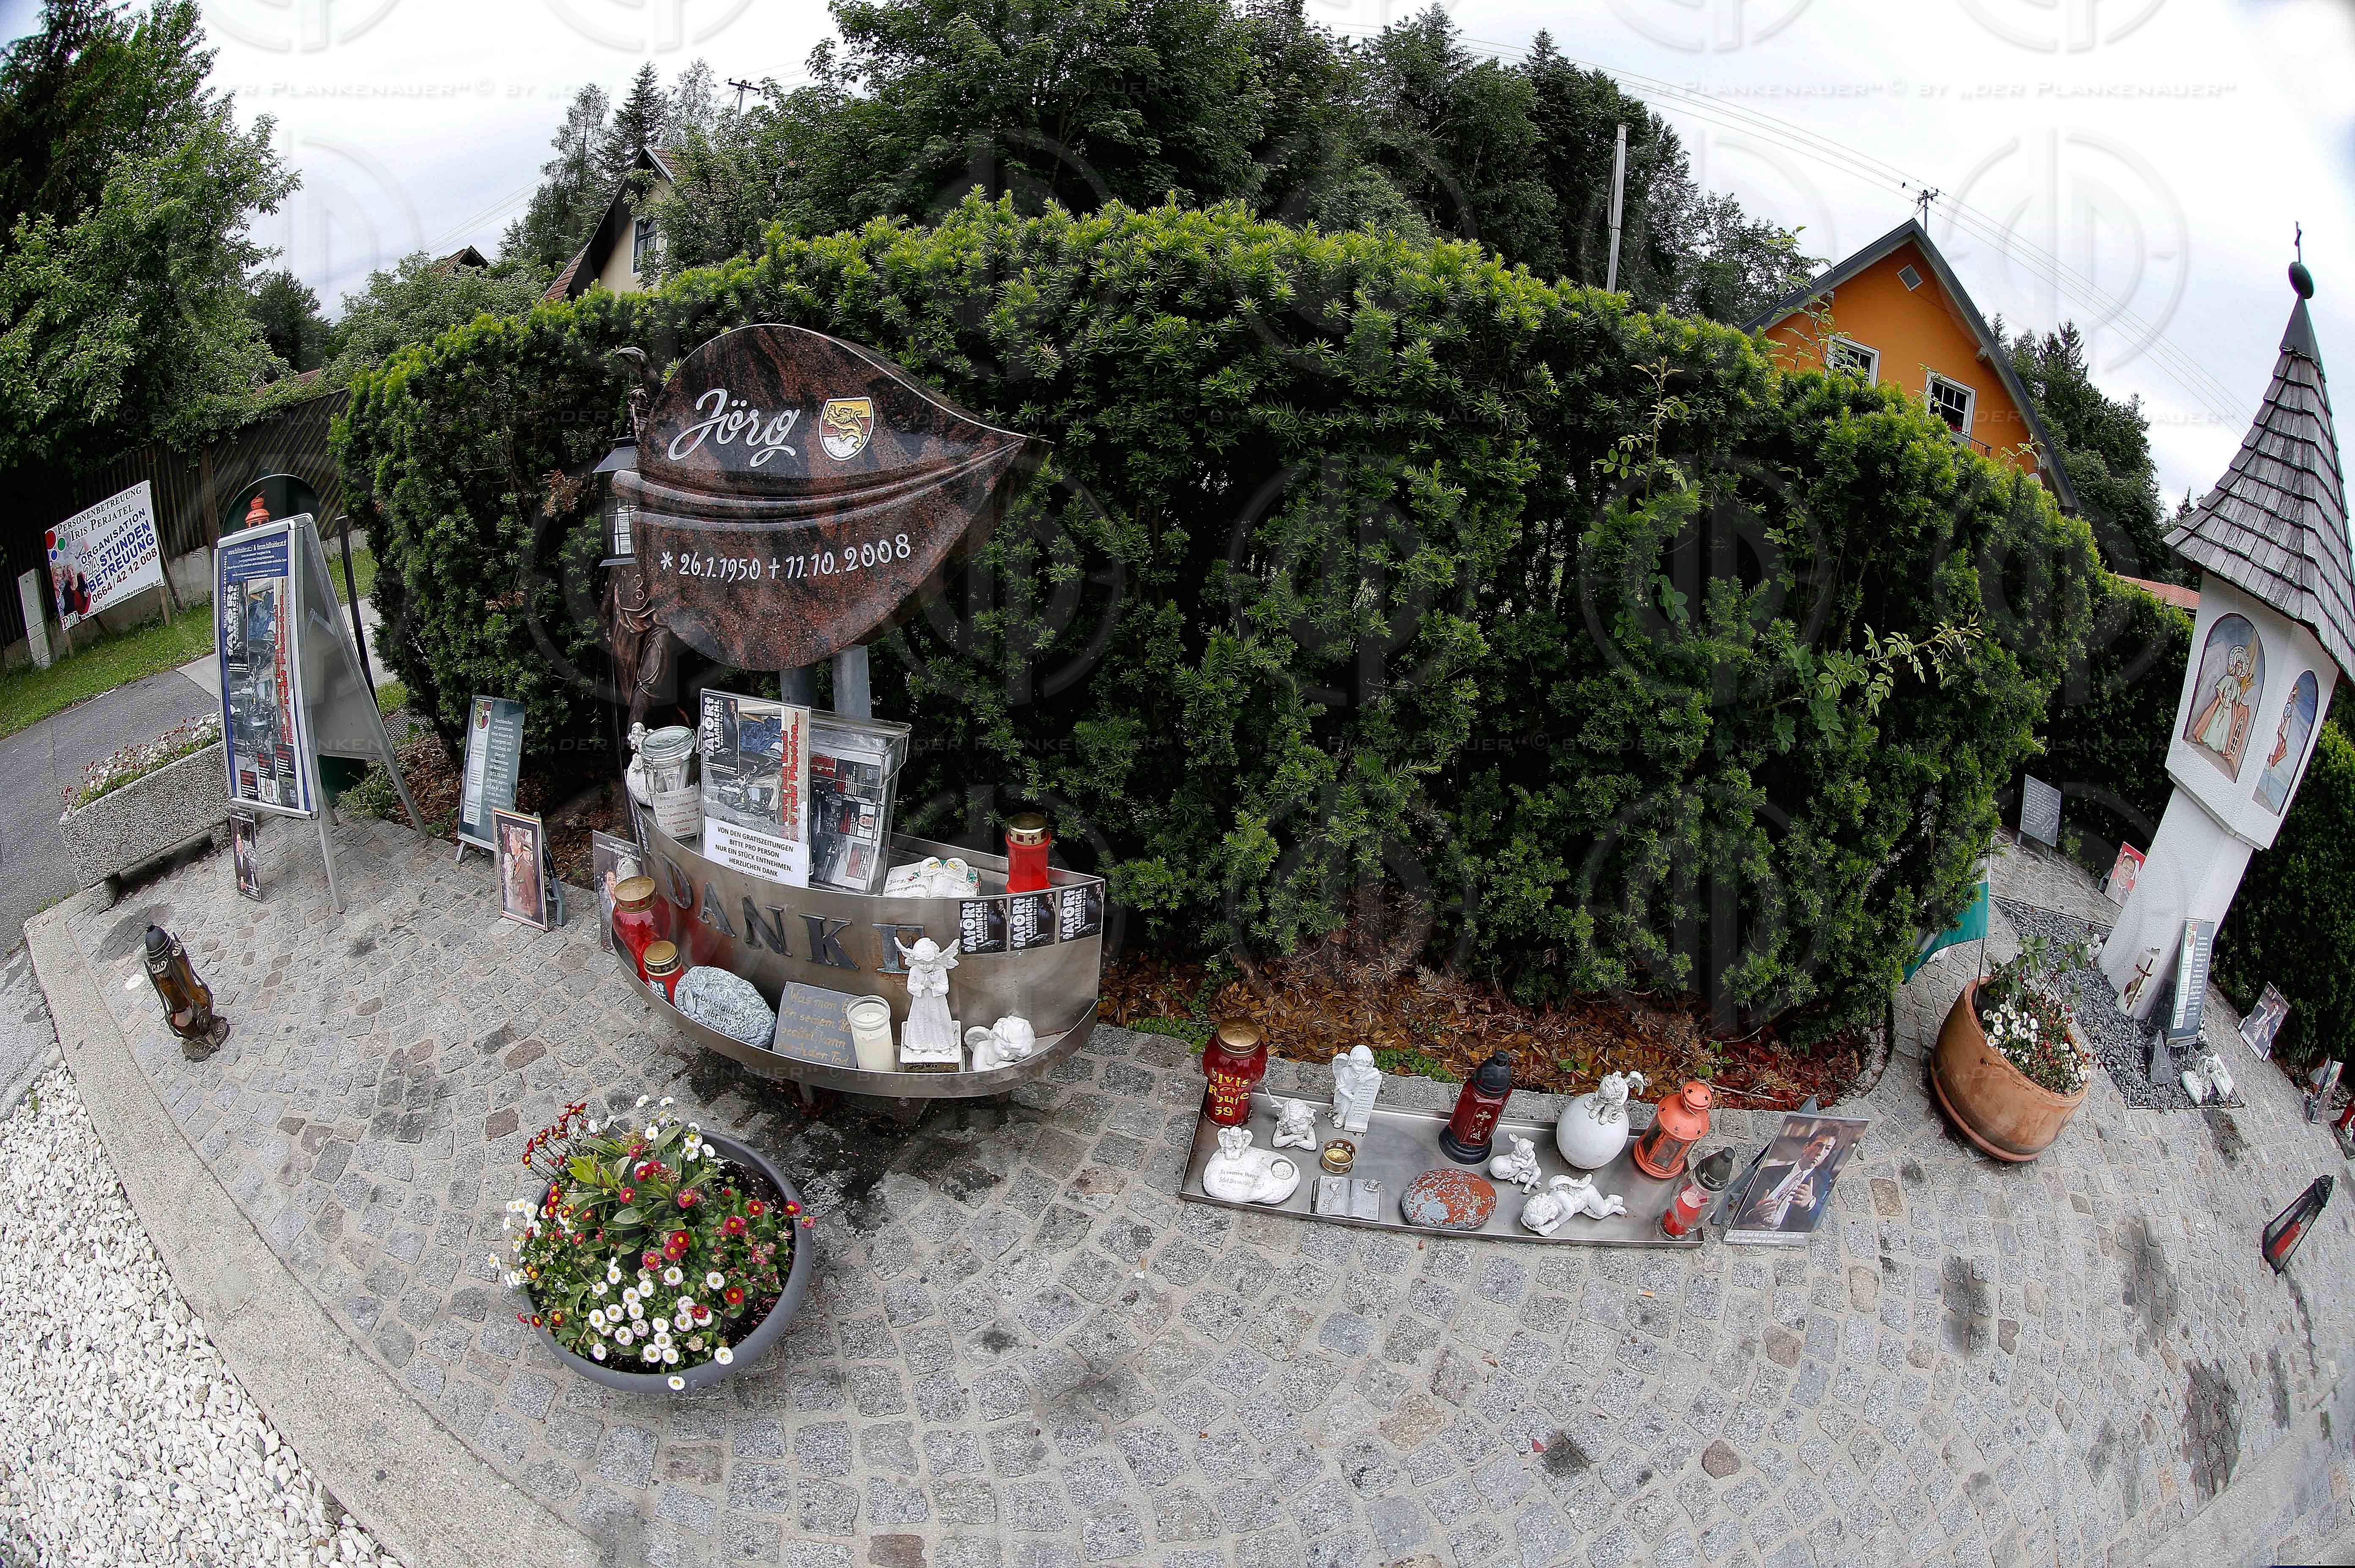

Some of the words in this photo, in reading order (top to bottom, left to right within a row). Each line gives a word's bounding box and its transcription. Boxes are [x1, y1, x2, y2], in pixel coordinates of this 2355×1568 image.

[669, 389, 800, 467] Jörg
[81, 507, 146, 565] ORGANISATION
[83, 558, 100, 581] 24
[100, 519, 151, 568] STUNDEN
[88, 532, 156, 593] BETREUUNG
[128, 561, 140, 578] 12
[141, 547, 158, 567] 008
[81, 577, 162, 620] www.iris-personenbetreuung.at
[717, 826, 729, 834] VON
[730, 830, 741, 838] DEN
[742, 833, 794, 853] GRATISZEITUNGEN
[729, 839, 744, 848] BITTE
[745, 844, 756, 852] PRO
[758, 847, 780, 858] PERSON
[728, 848, 737, 856] EIN
[738, 850, 755, 861] STÜCK
[756, 856, 793, 872] ENTNEHMEN.
[729, 857, 761, 872] HERZLICHEN
[762, 867, 778, 877] DANK
[658, 853, 926, 975] DANKE
[975, 902, 984, 943] LAMBICHL
[1025, 896, 1033, 938] LAMBICHL
[1074, 888, 1083, 929] LAMBICHL
[700, 993, 712, 1006] Der
[704, 1009, 719, 1020] gibt
[719, 1016, 732, 1026] uns
[707, 1020, 726, 1033] Kraft
[831, 1050, 850, 1066] Tod
[1215, 1106, 1233, 1116] 59
